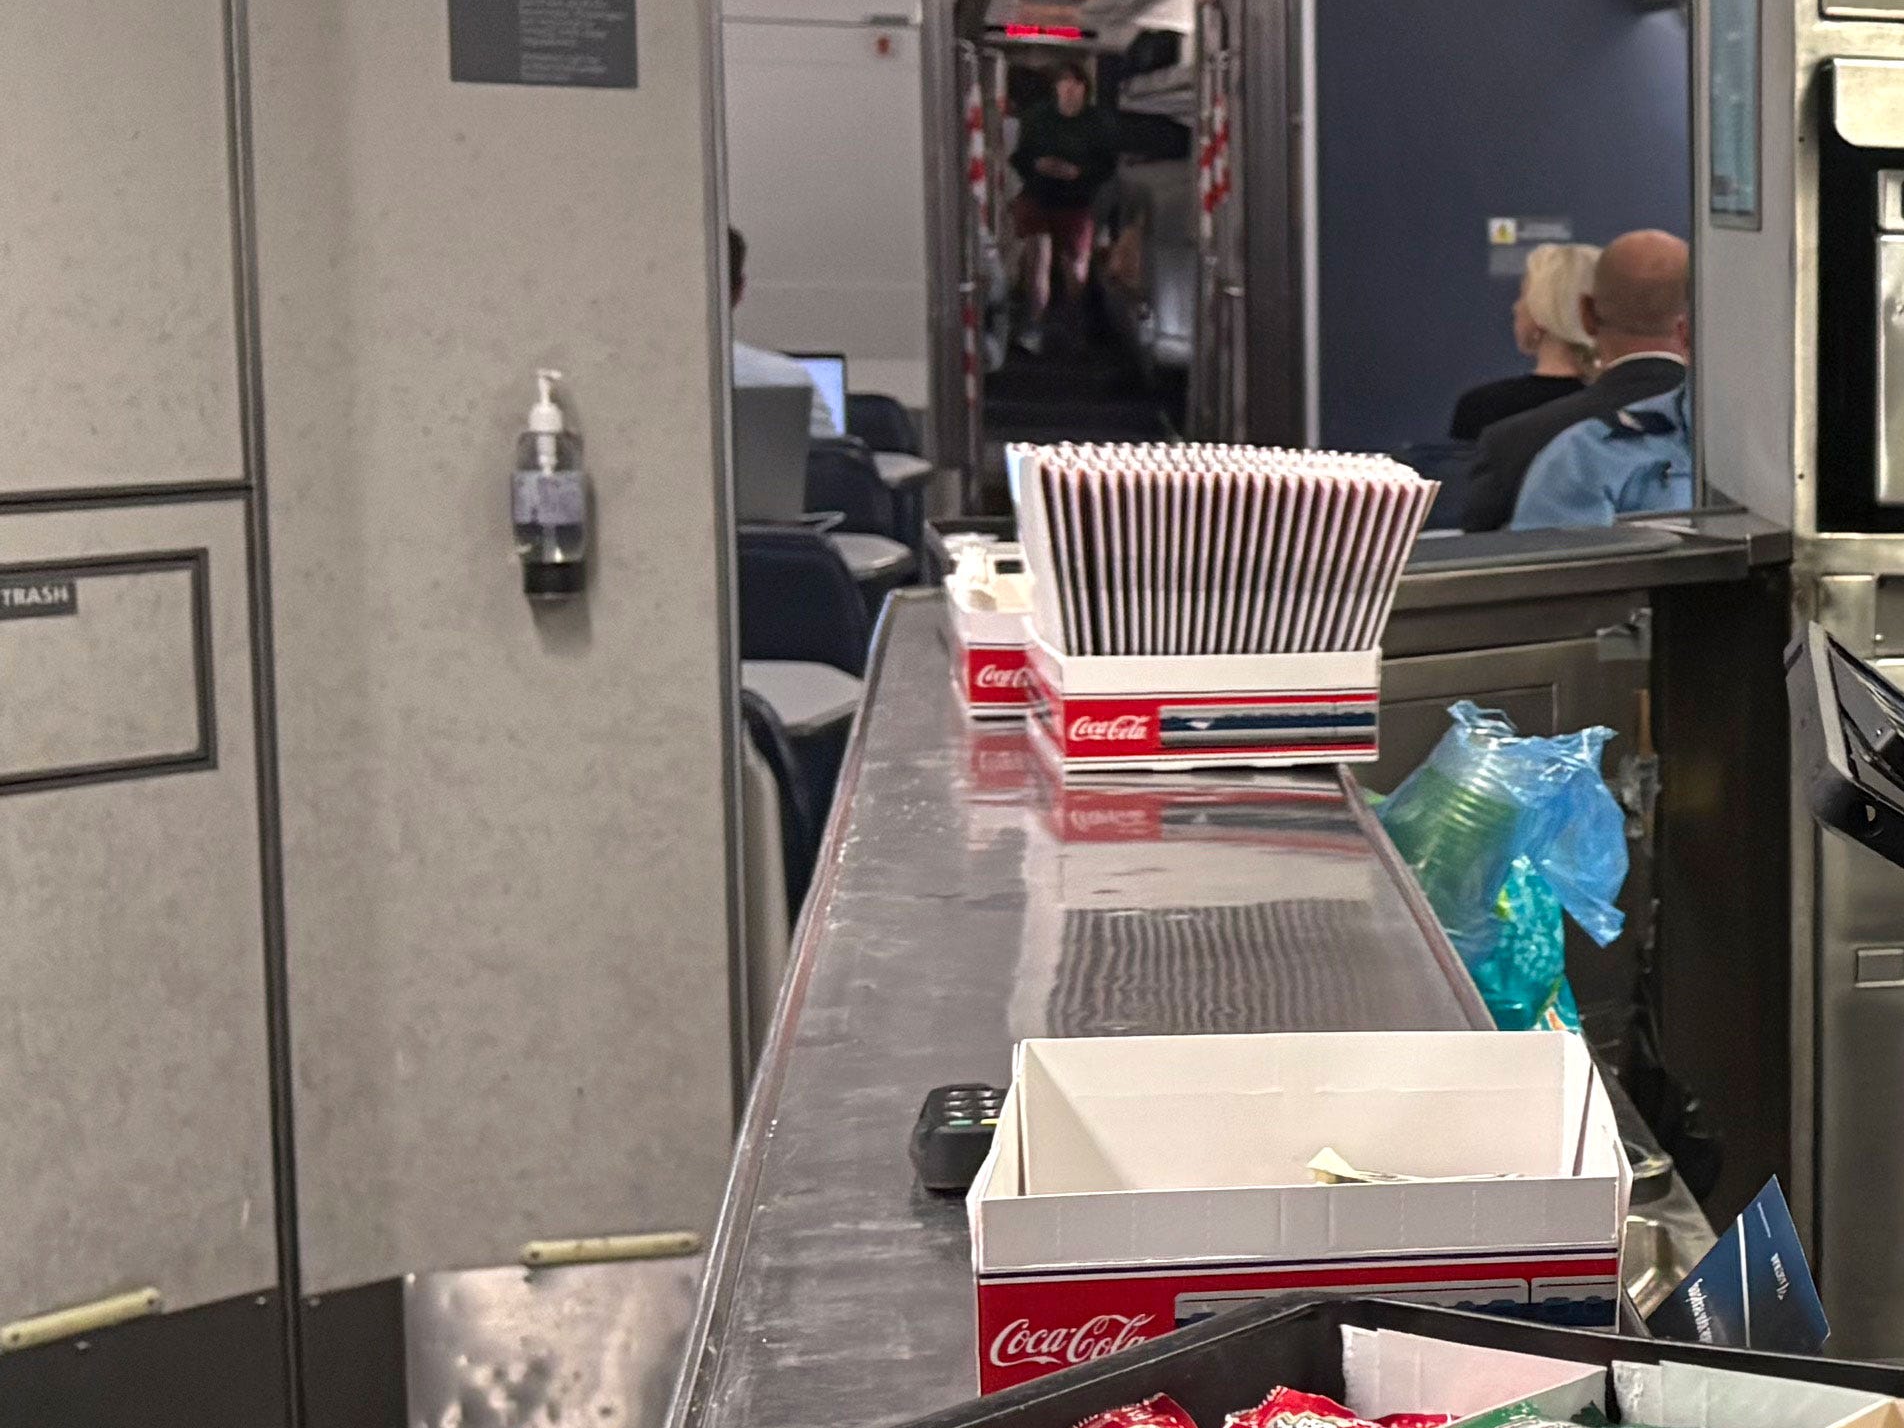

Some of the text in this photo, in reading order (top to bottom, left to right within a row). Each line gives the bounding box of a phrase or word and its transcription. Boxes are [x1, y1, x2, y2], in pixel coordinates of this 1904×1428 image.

[1, 585, 70, 608] TRASH
[1069, 714, 1150, 743] Coca-Cola
[990, 1313, 1154, 1367] Coca-Cola
